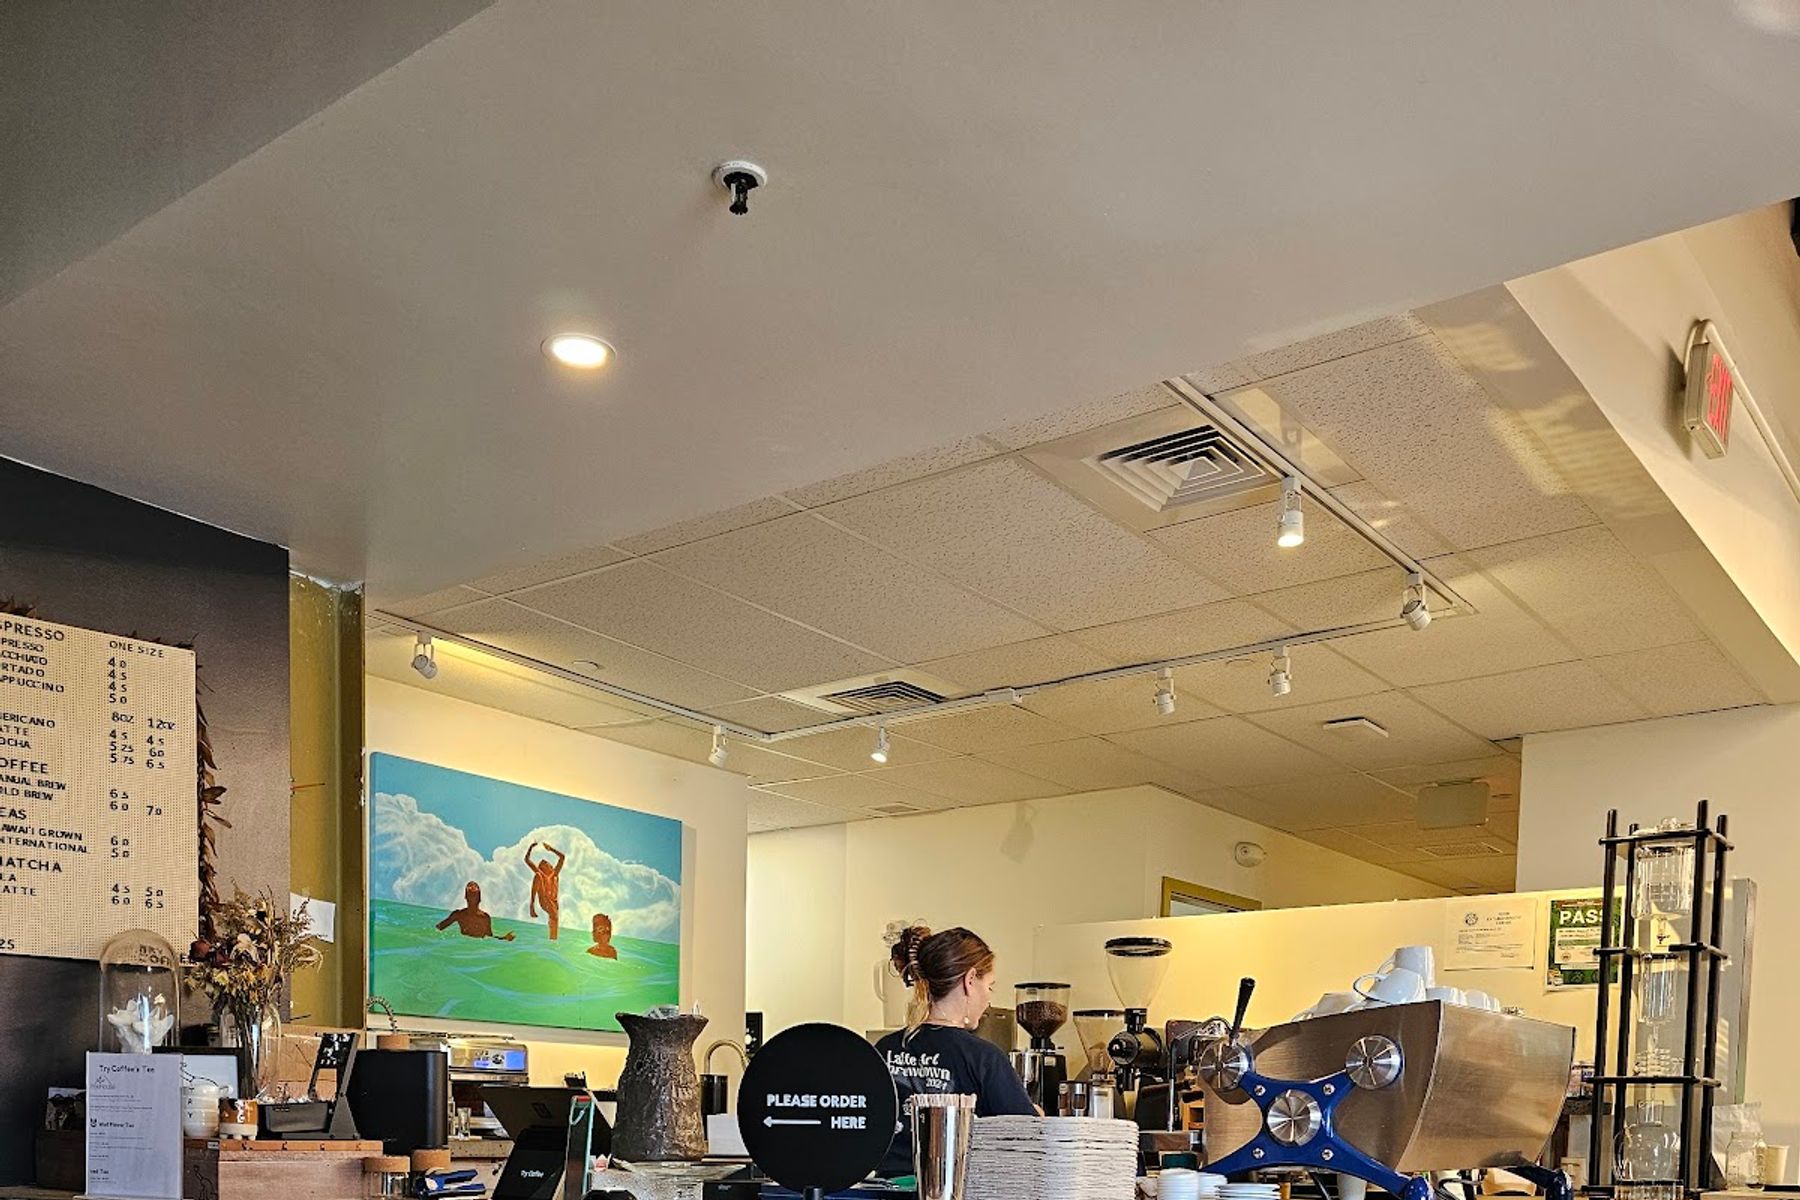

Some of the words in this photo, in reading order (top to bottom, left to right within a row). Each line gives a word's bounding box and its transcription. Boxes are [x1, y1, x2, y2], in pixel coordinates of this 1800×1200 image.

[0, 620, 64, 641] PRESSO
[109, 640, 134, 652] ONE
[138, 646, 165, 658] SIZE
[0, 712, 56, 728] ERICANO
[1559, 909, 1603, 925] PAS
[766, 1094, 818, 1108] PLEASE
[819, 1095, 867, 1109] ORDER
[830, 1116, 867, 1130] HERE
